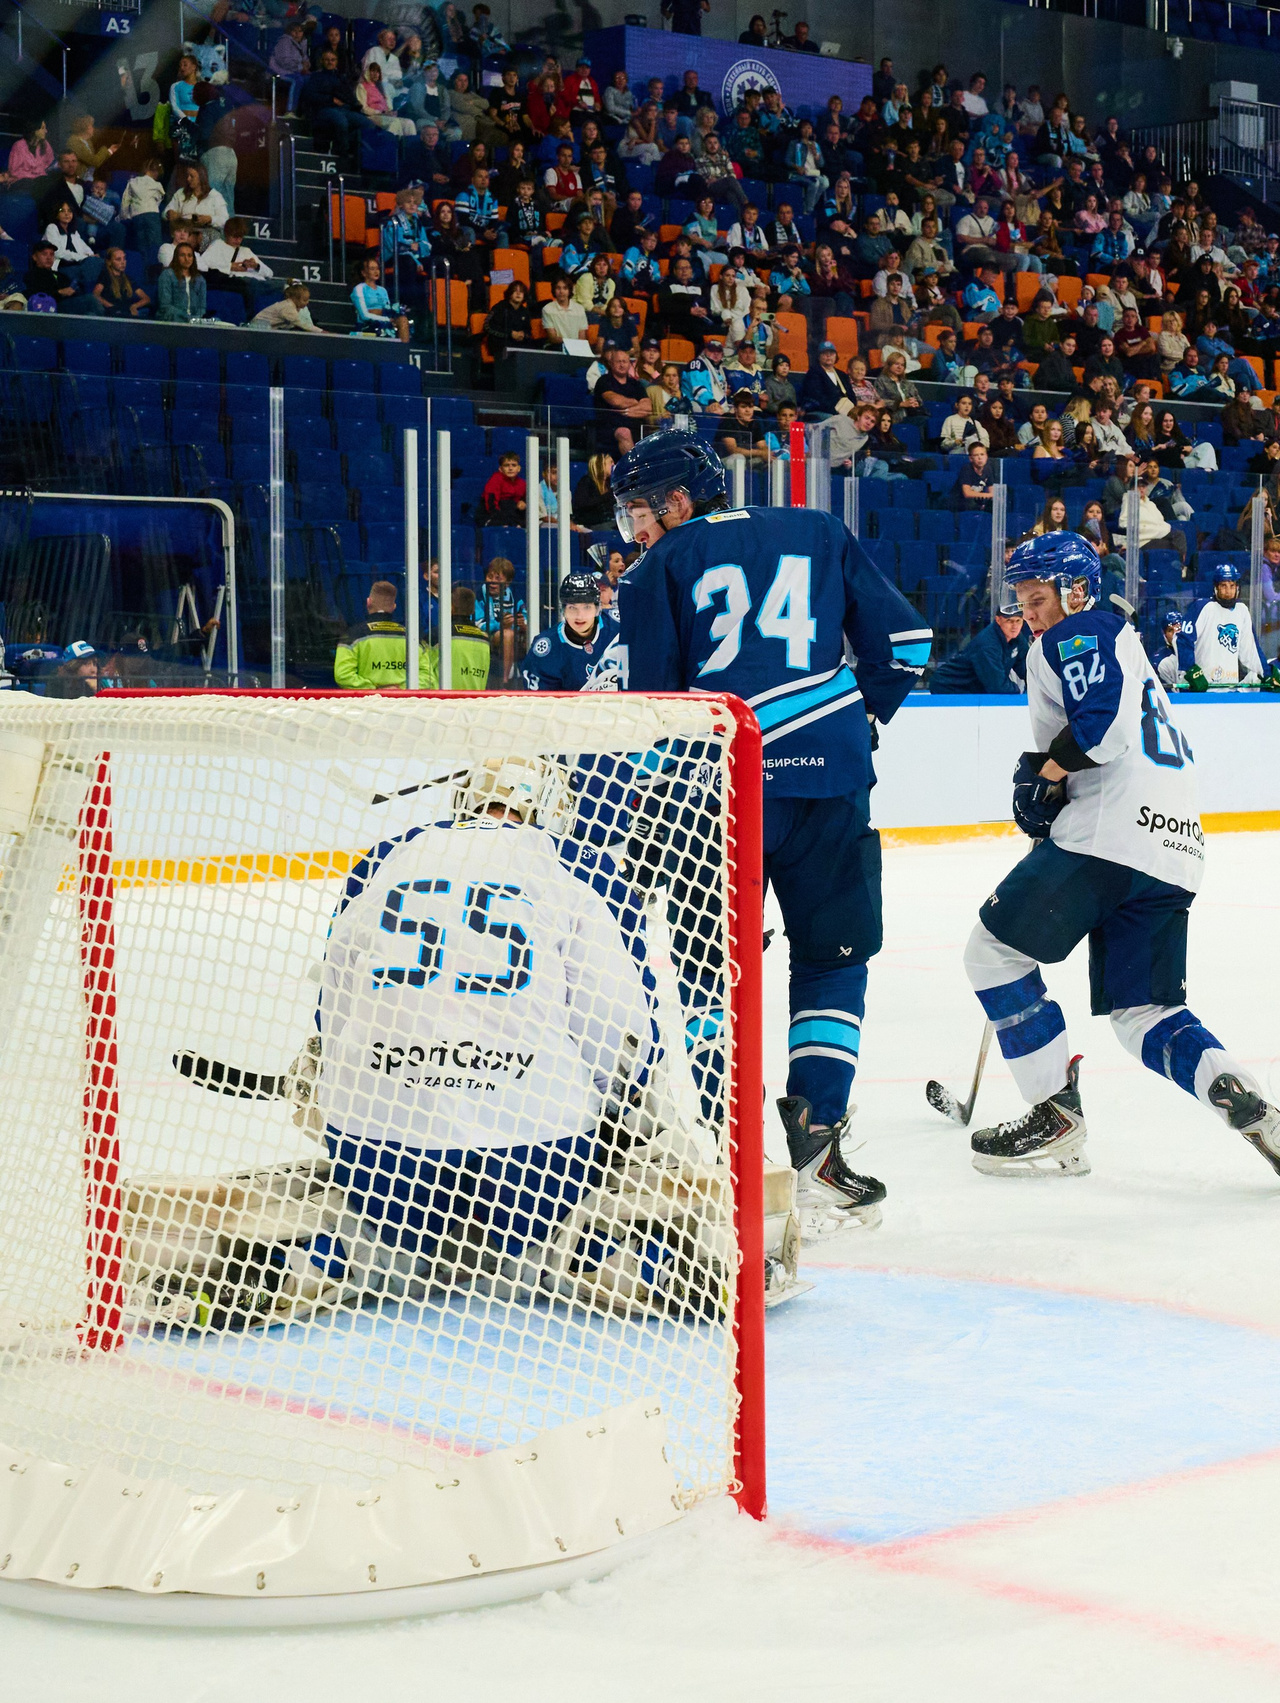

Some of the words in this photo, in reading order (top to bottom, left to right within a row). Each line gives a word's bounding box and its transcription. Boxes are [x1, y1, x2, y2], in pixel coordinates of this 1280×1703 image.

[106, 17, 130, 34] A3
[320, 160, 337, 174] 16
[253, 222, 271, 239] 14
[302, 265, 321, 282] 13
[692, 554, 817, 678] 34
[1182, 621, 1194, 634] 16
[1063, 652, 1106, 701] 84
[1140, 677, 1194, 770] 8
[762, 757, 825, 769] ИБИРСКАЯ
[372, 878, 534, 997] 55
